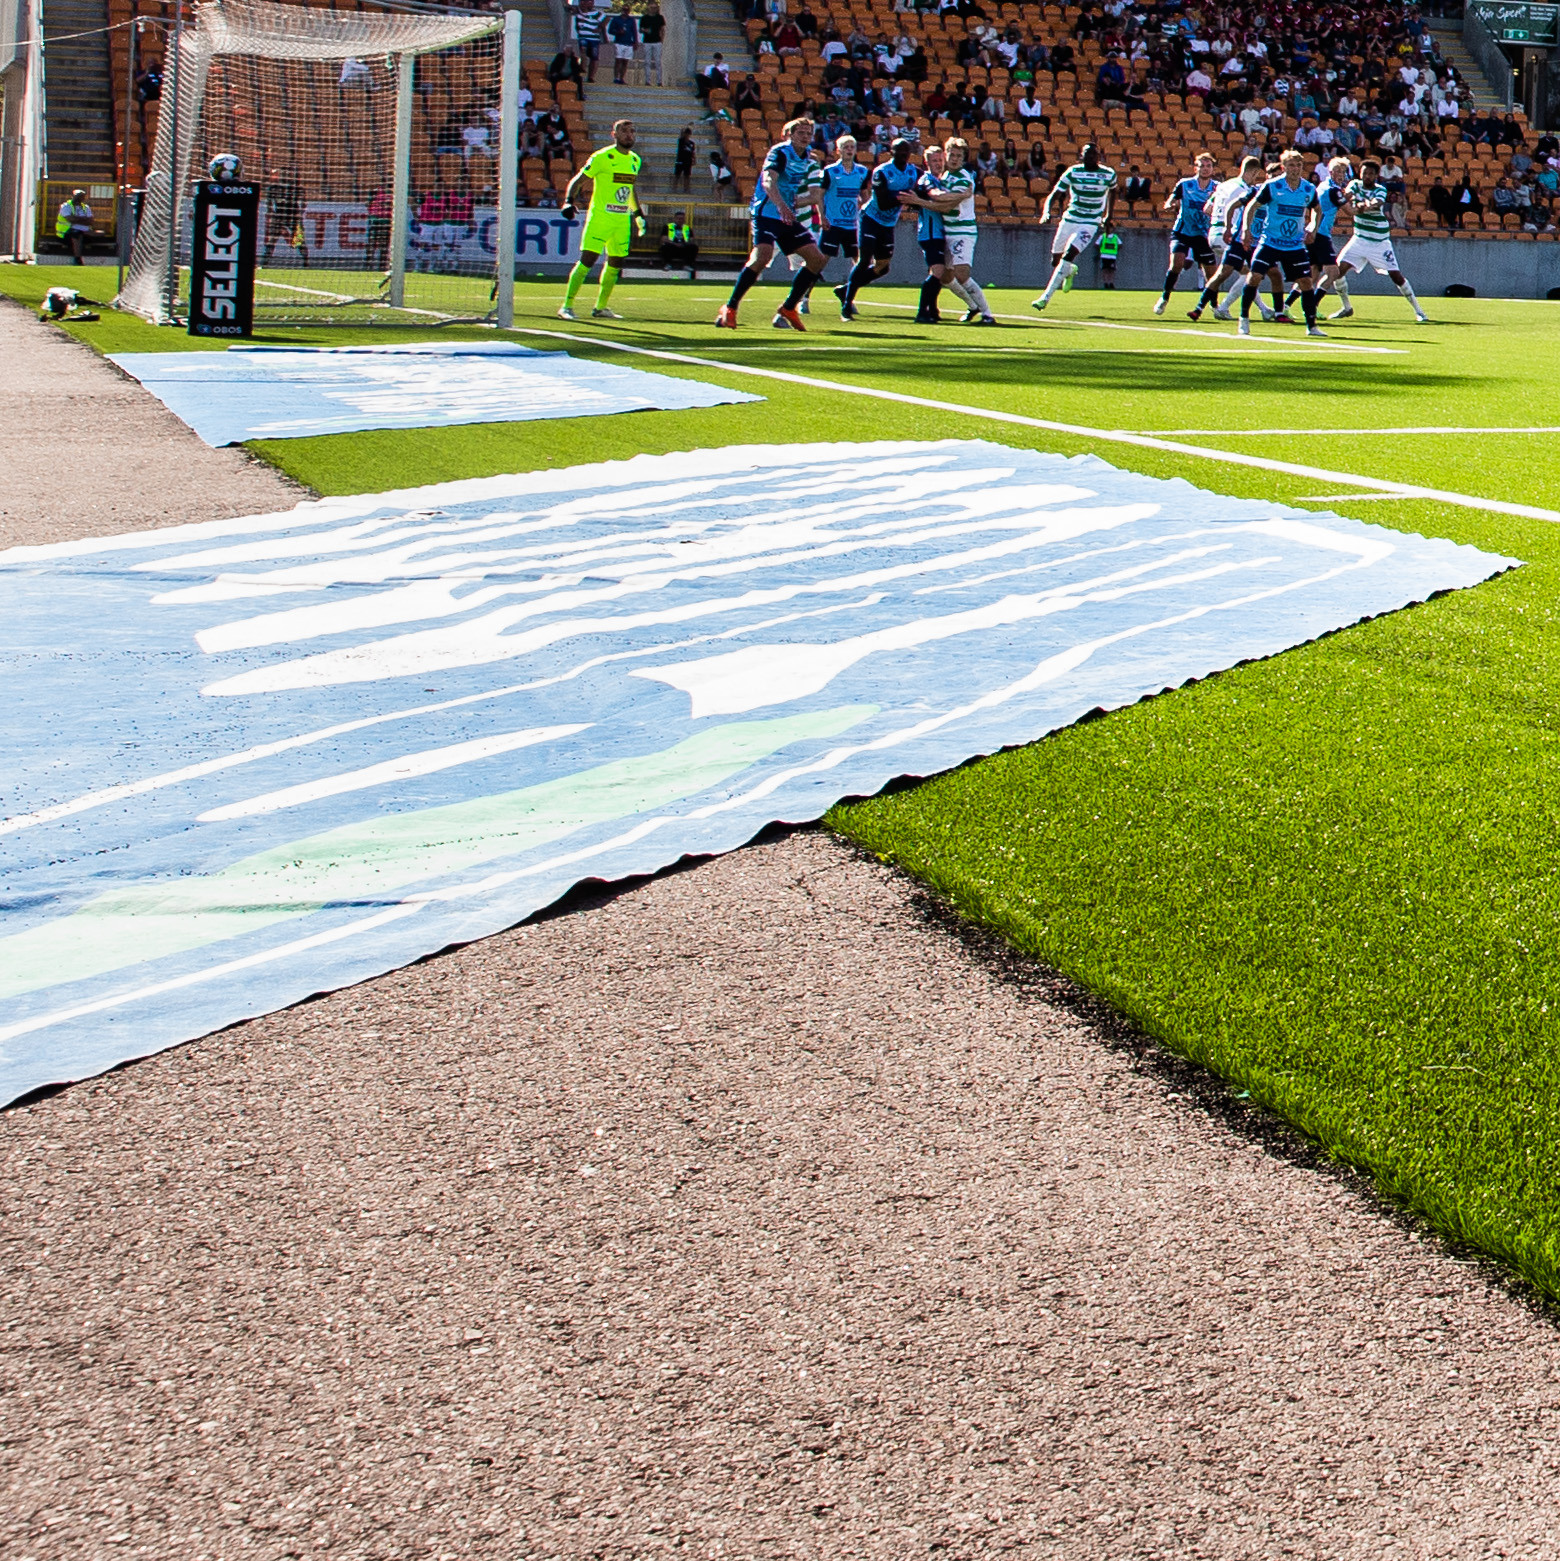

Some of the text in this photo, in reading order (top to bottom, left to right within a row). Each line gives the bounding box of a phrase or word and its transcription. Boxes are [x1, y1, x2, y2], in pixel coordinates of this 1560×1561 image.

[224, 186, 252, 194] OBOS
[202, 204, 241, 320] SELECT
[213, 326, 242, 334] OBOS
